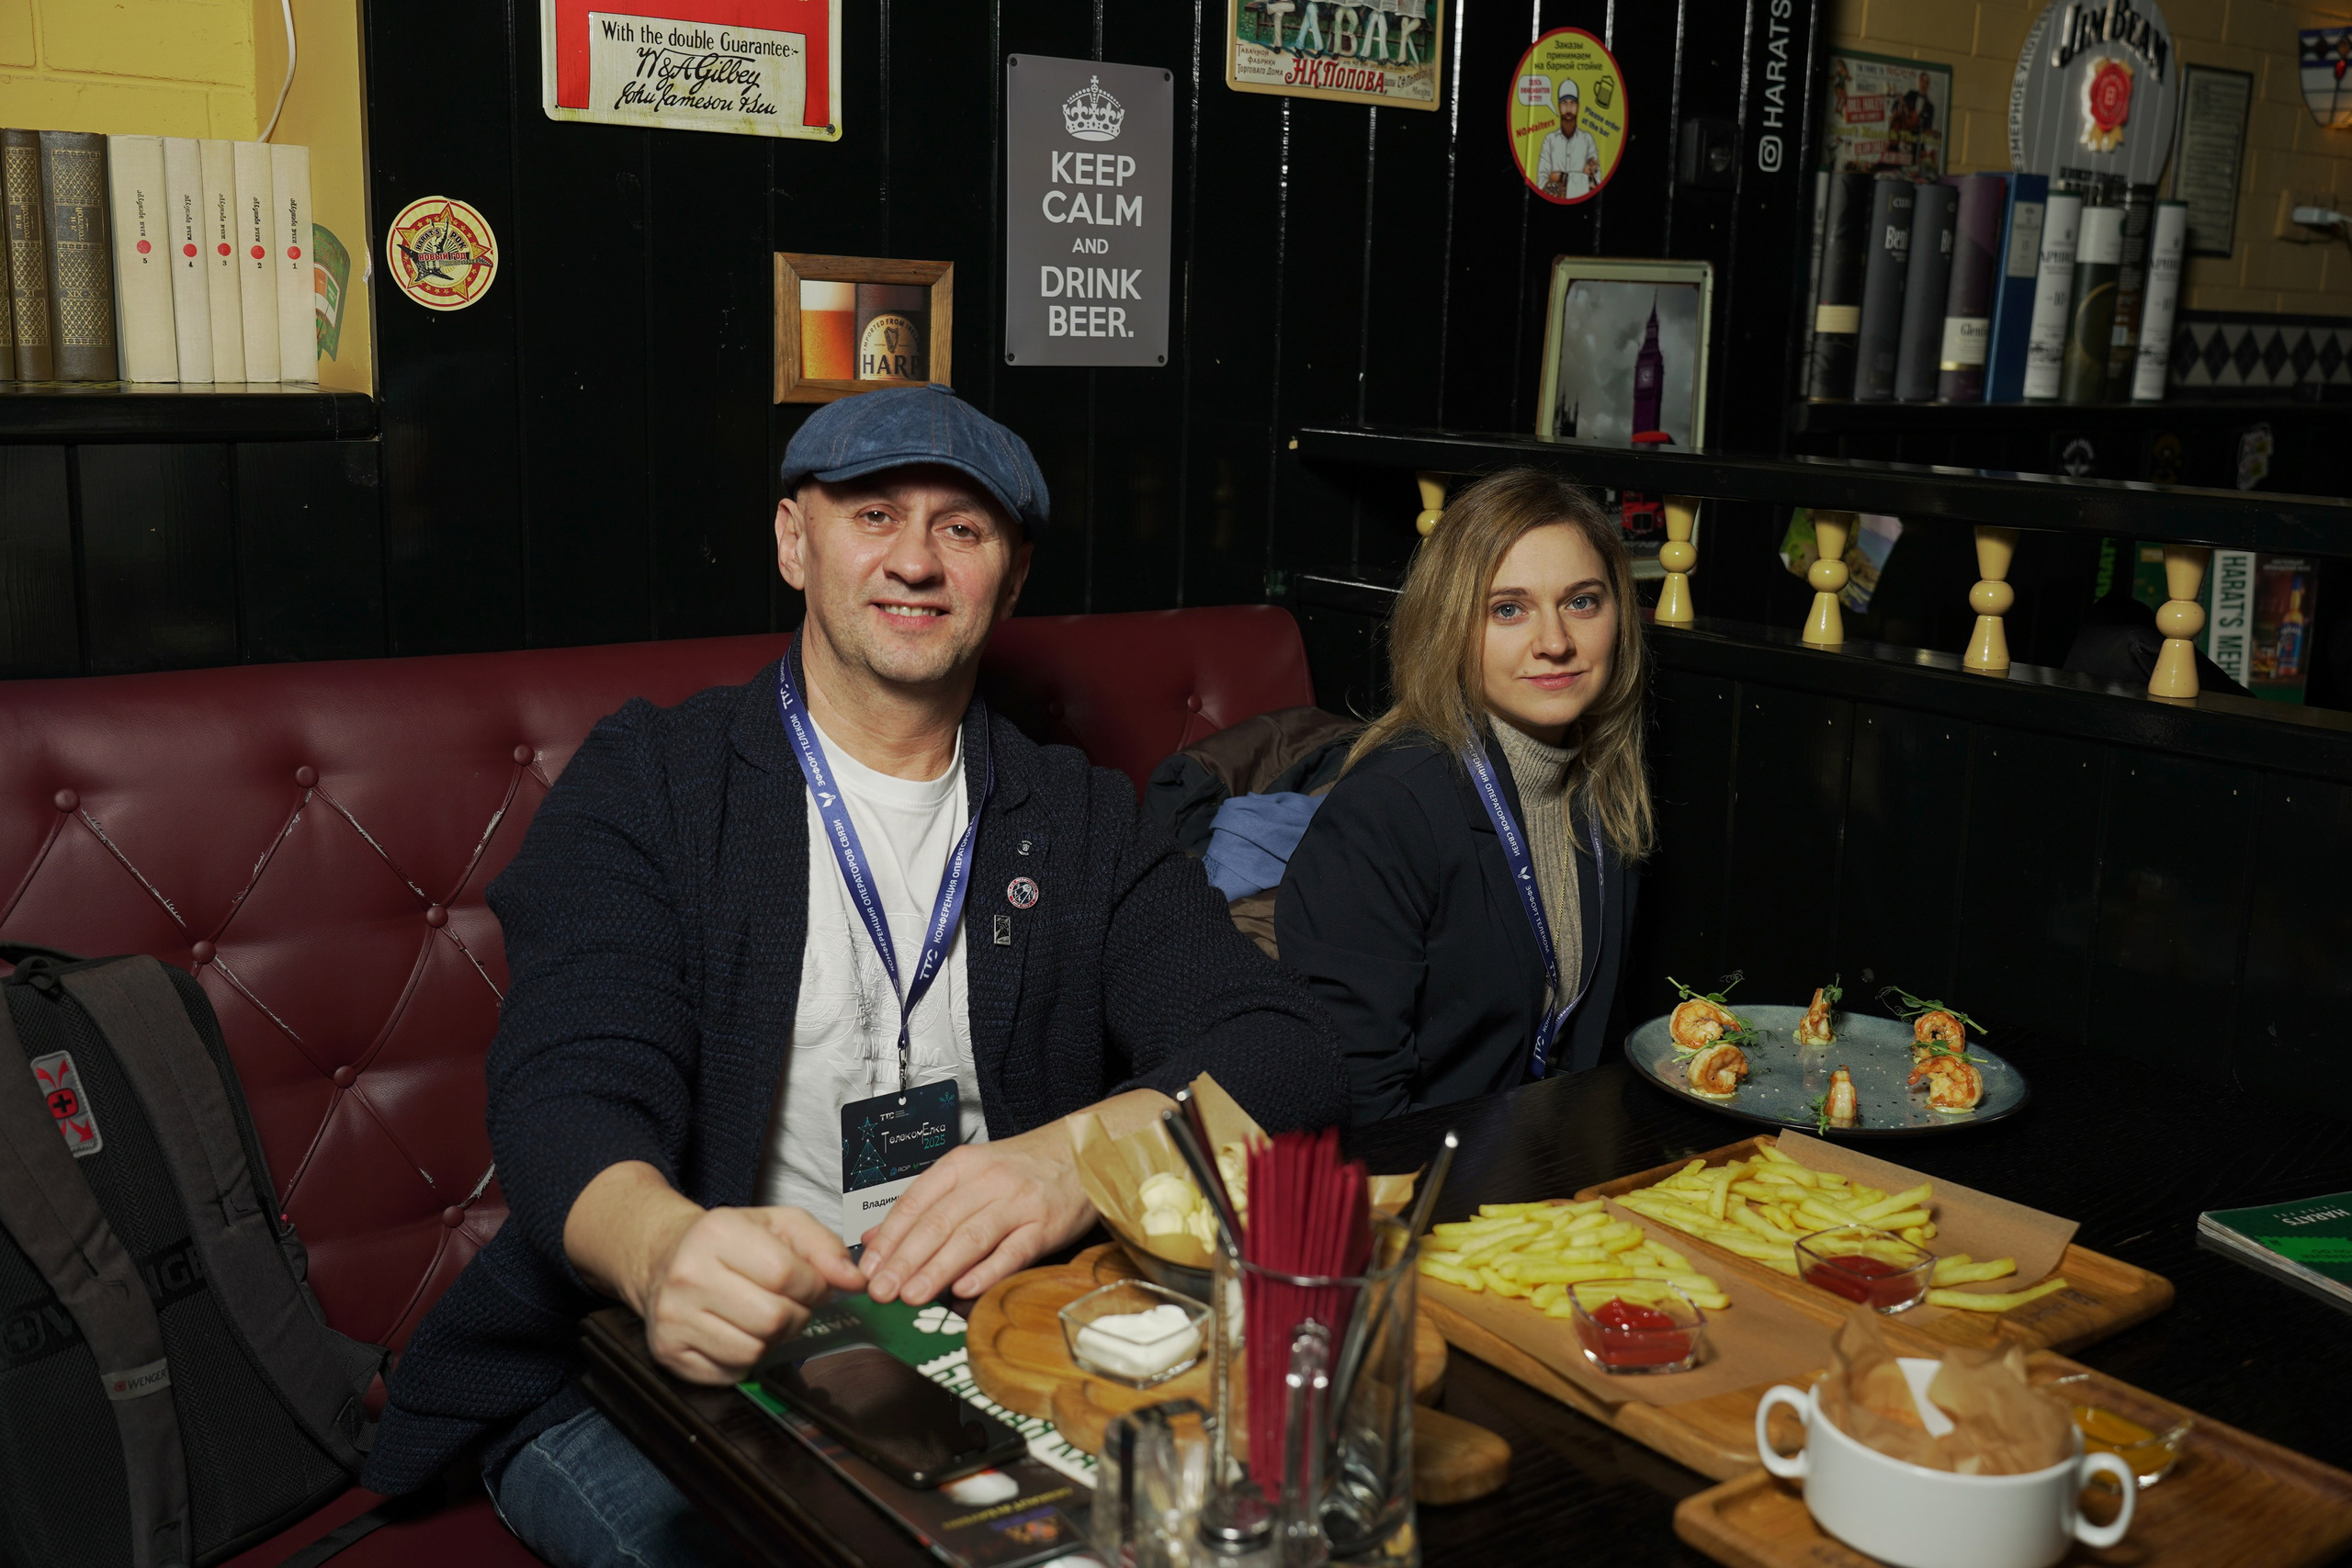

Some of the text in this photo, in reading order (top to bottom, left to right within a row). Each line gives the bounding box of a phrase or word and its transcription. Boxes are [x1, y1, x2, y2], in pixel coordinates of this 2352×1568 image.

[601, 19, 635, 43] With
[640, 26, 663, 45] the
[668, 28, 715, 51] double
[1555, 39, 1583, 50] Заказы
[1534, 60, 1602, 72] на барной стойке
[1546, 51, 1591, 62] принимаем
[1051, 150, 1136, 187] KEEP
[20, 205, 31, 241] ТОЛСТОЙ
[75, 206, 85, 242] ТОЛСТОЙ
[1042, 189, 1143, 227] CALM
[414, 227, 441, 252] HARAT'S
[449, 229, 469, 251] РОК
[1071, 237, 1110, 255] AND
[417, 252, 467, 262] НОВЫЙ ГОД
[1040, 265, 1143, 300] DRINK
[863, 319, 885, 351] IMPORTED
[886, 318, 905, 327] FROM
[1048, 305, 1135, 338] BEER.
[862, 354, 921, 378] HARP
[2218, 556, 2247, 629] HARAT'S
[789, 713, 826, 787] ЭФФОРТ ТЕЛЕКОМ
[1485, 782, 1510, 832] ОПЕРАТОРОВ
[1506, 831, 1521, 857] СВЯЗИ
[833, 818, 896, 973] КОНФЕРЕНЦИЯ ОПЕРАТОРОВ СВЯЗИ
[933, 824, 974, 944] КОНФЕРЕНЦИЯ ОПЕРАТОРОВ
[1525, 885, 1551, 954] ЭФФОРТ ТЕЛЕКОМ
[923, 1134, 946, 1150] 2025
[127, 1368, 167, 1391] WENGER
